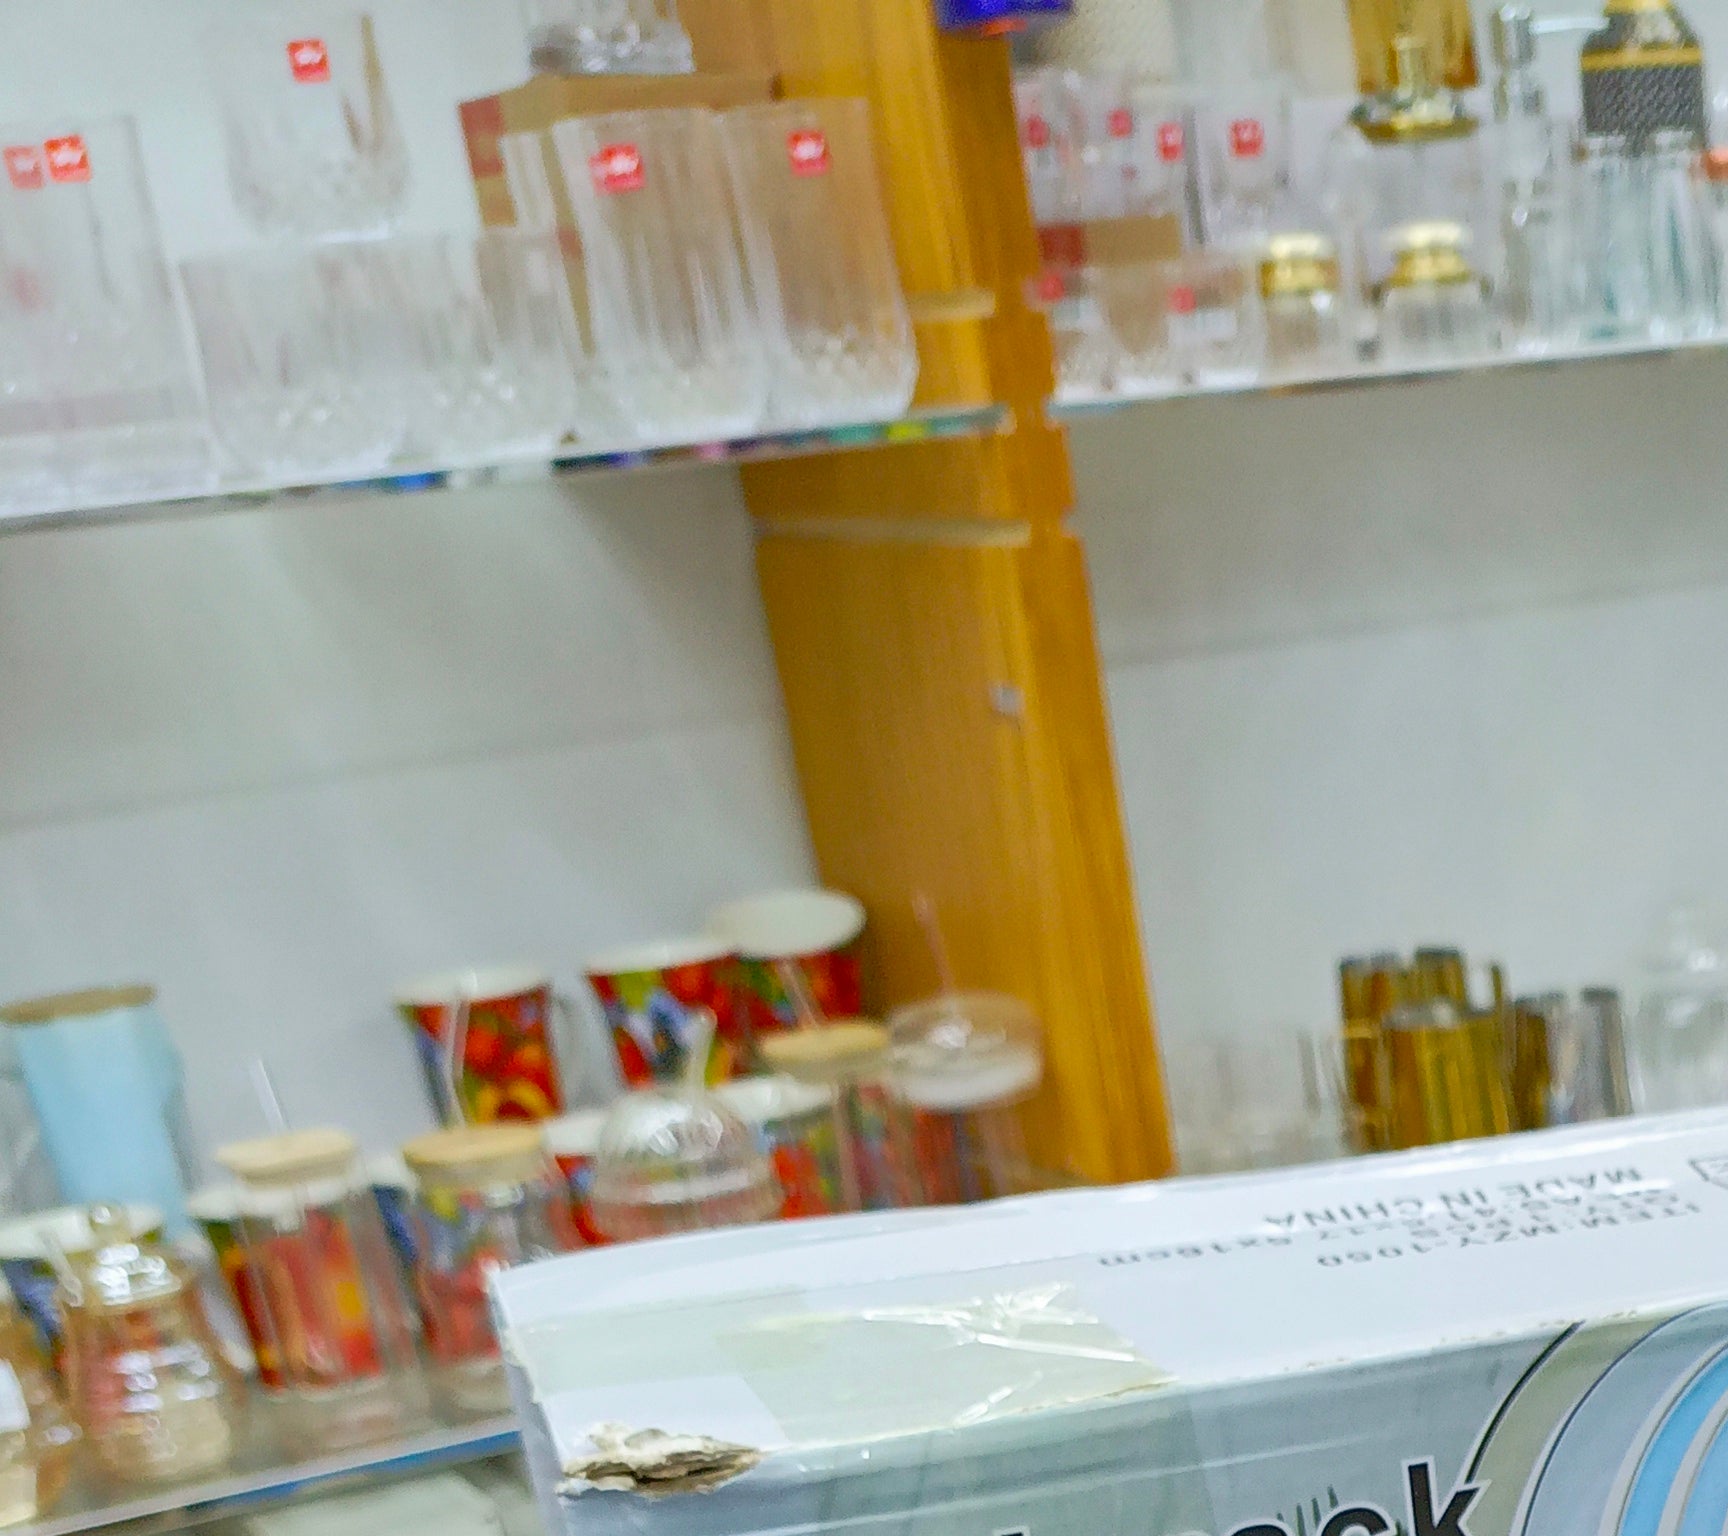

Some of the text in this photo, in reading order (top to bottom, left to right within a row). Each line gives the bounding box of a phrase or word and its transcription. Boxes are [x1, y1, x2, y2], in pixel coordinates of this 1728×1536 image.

[1264, 1167, 1642, 1226] MADE IN CHINA
